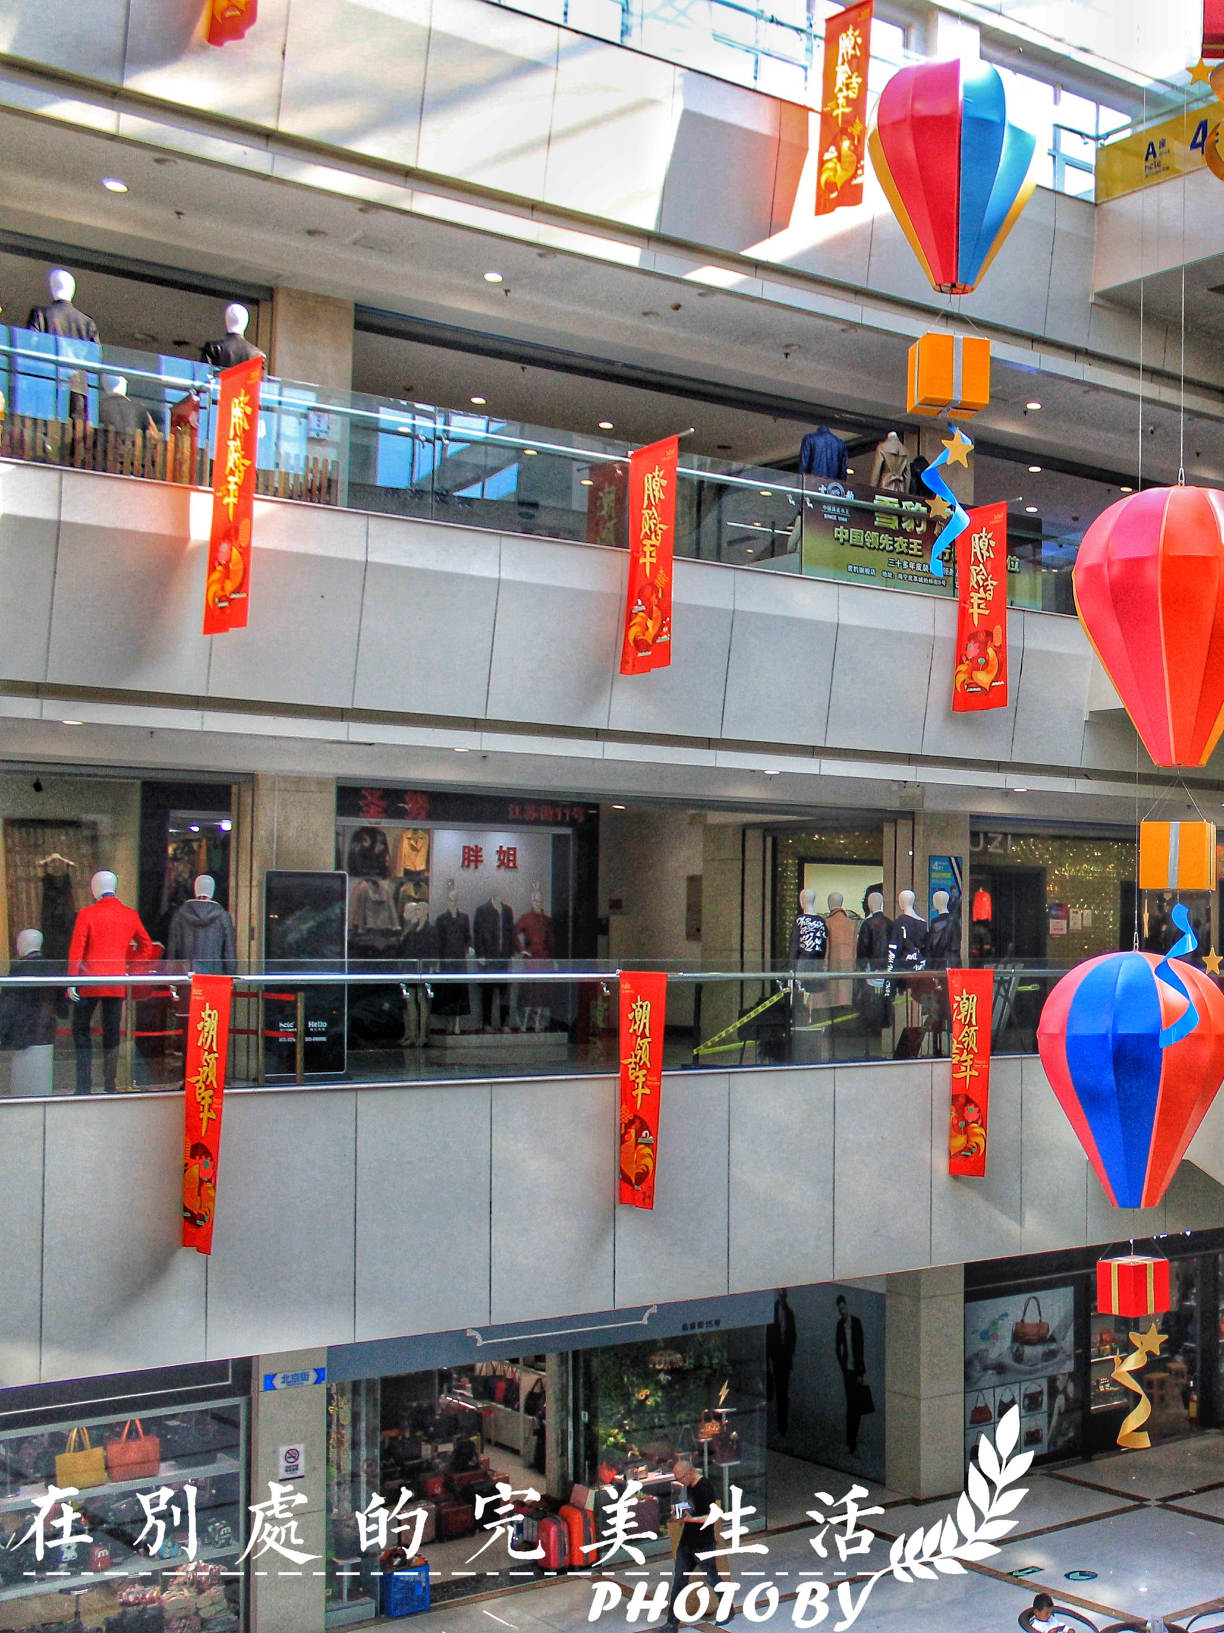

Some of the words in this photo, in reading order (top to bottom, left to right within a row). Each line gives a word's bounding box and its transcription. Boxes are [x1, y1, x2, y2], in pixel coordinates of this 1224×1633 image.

[833, 525, 924, 558] 中国领先衣王
[460, 844, 519, 870] 胖姐
